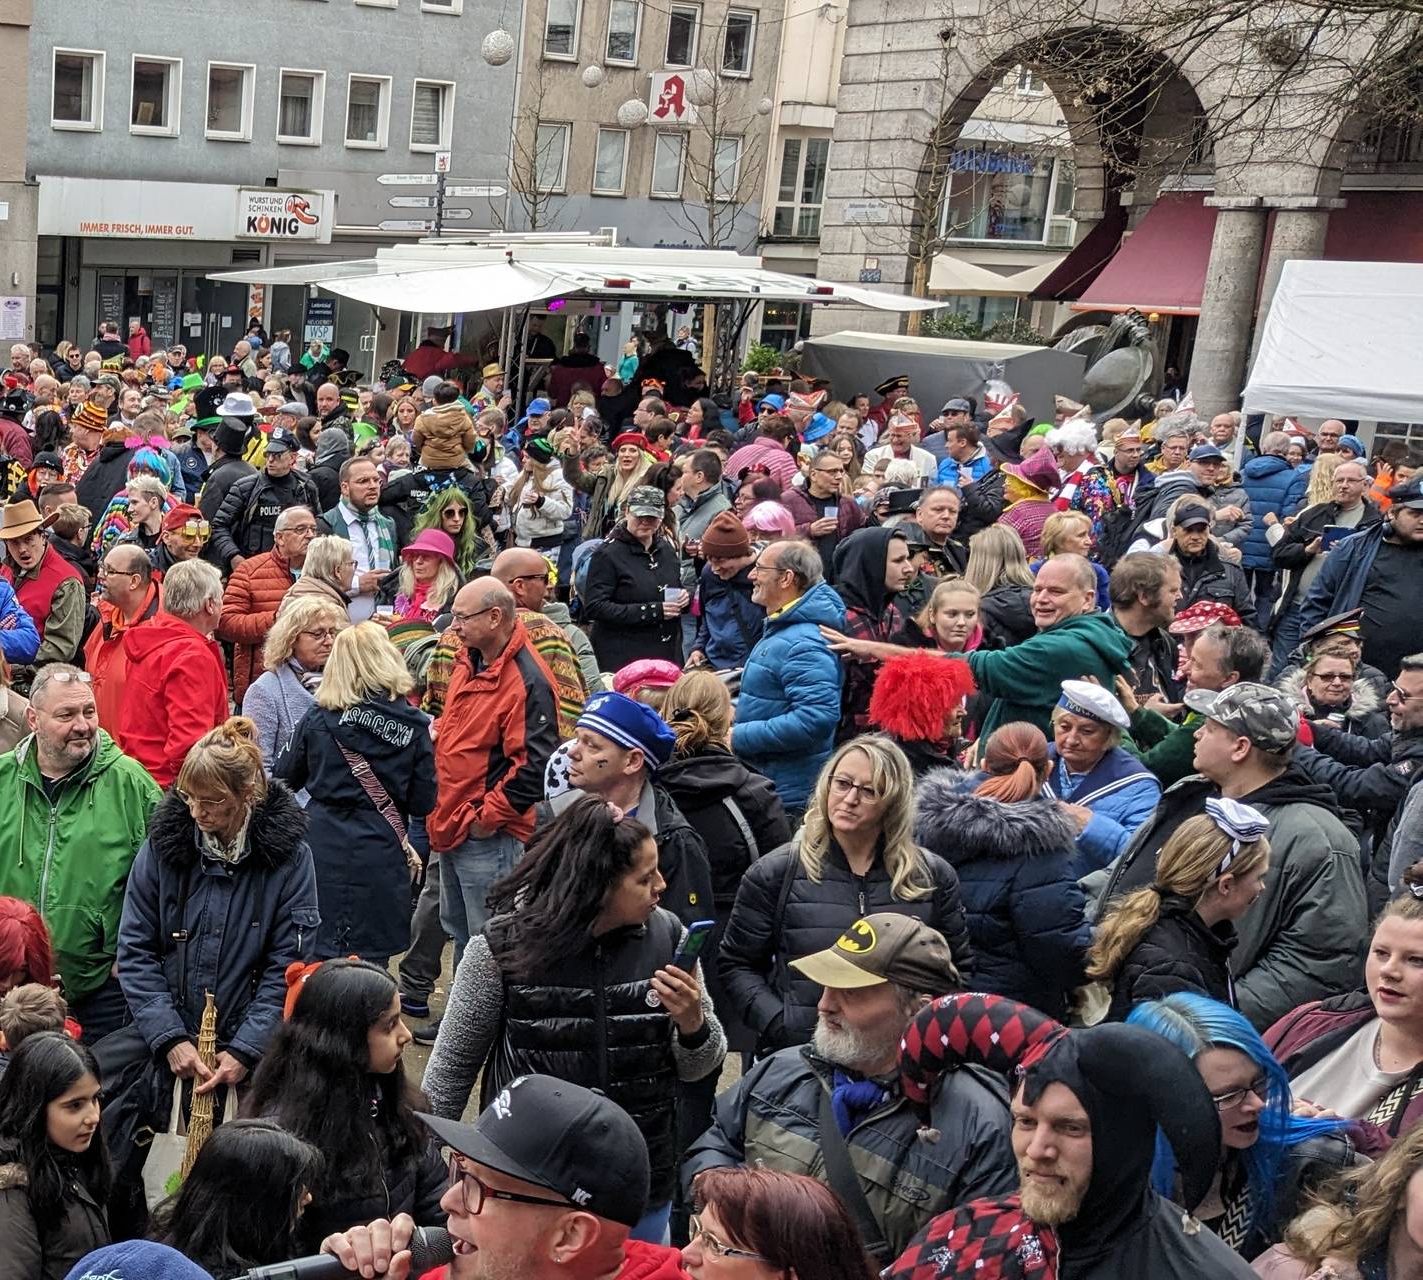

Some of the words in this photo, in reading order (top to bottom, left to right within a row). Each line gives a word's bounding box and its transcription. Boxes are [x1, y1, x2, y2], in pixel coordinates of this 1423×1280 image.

[249, 196, 269, 204] WURST
[270, 197, 283, 205] UND
[248, 205, 283, 213] SCHINKEN
[80, 222, 109, 233] IMMER
[111, 223, 144, 235] FRISCH,
[145, 224, 173, 234] IMMER
[175, 225, 195, 235] GUT.
[247, 213, 299, 235] KÖNIG
[310, 326, 329, 338] WSP
[260, 505, 282, 517] POLICE
